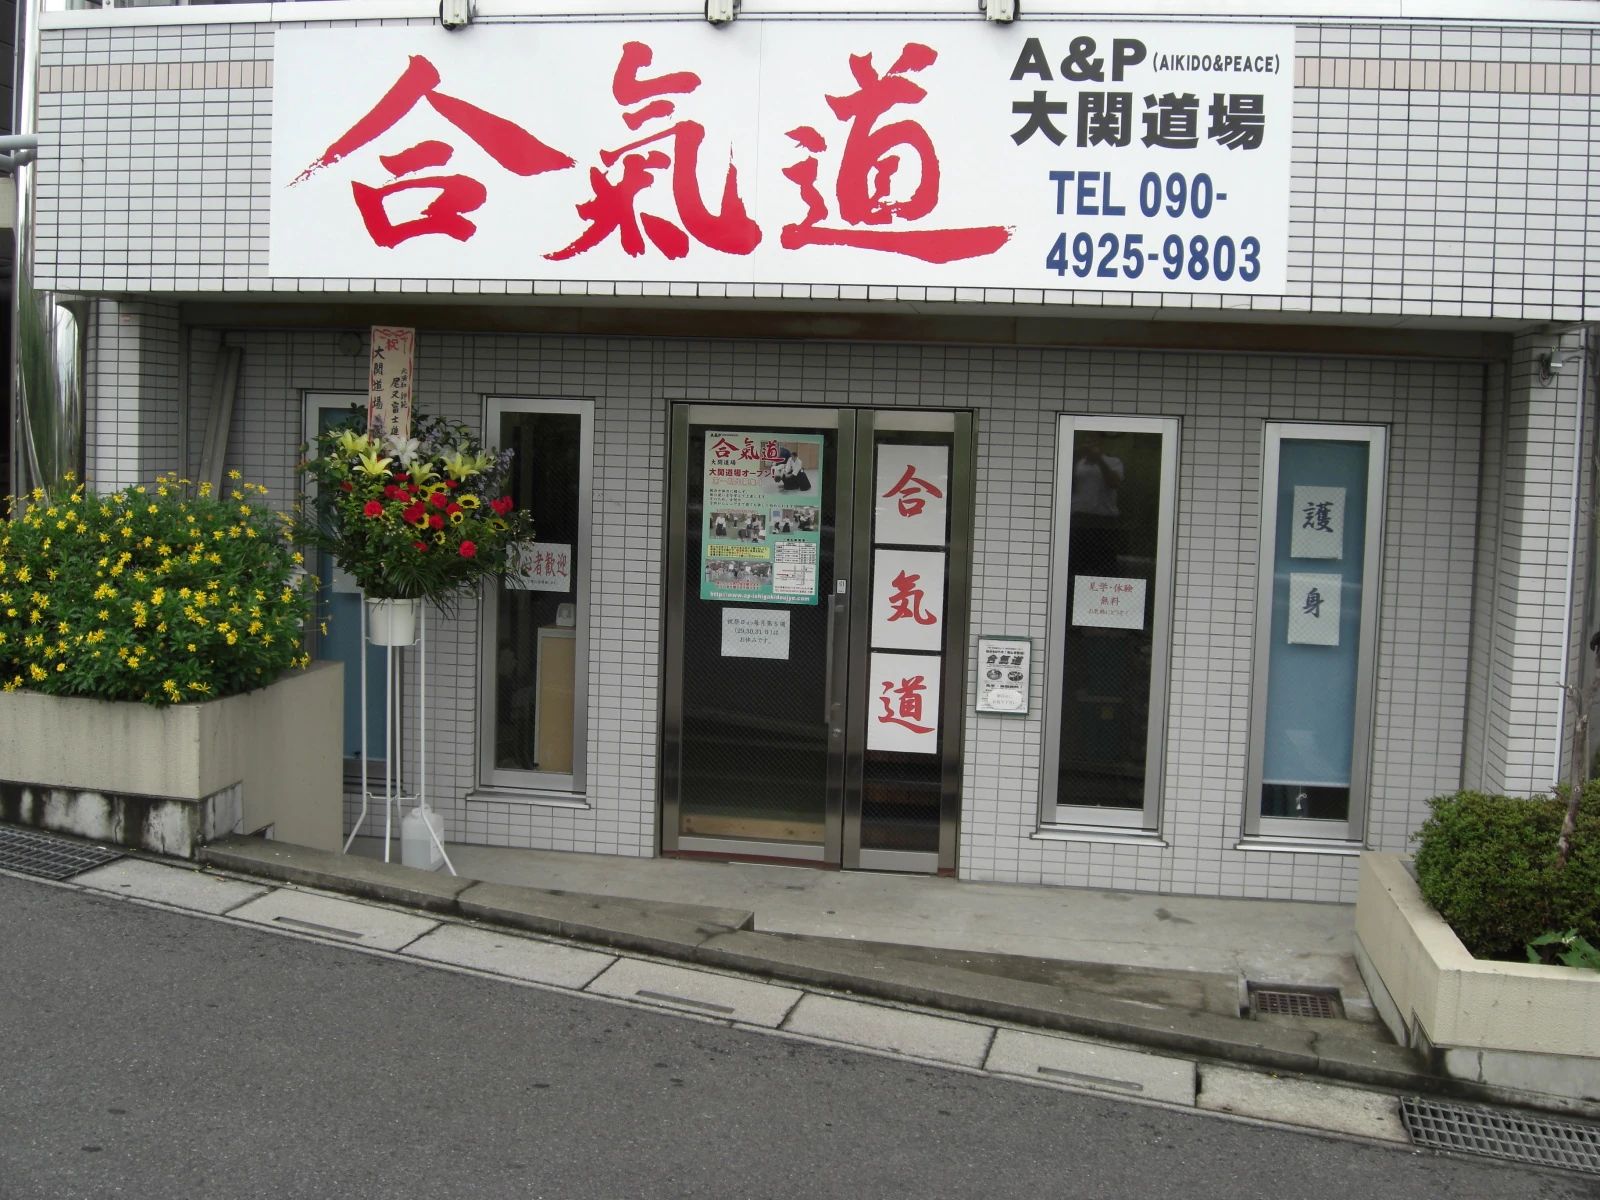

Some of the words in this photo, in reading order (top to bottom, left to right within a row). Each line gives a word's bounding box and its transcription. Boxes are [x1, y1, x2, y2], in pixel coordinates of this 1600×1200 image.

[1010, 36, 1147, 82] A&P
[1153, 52, 1280, 75] (AIKIDO&PEACE)
[1010, 90, 1265, 150] 大関道場
[288, 41, 1015, 264] 合氣道
[1049, 170, 1126, 216] TEL
[1139, 171, 1228, 219] 090-
[1046, 232, 1261, 282] 4925-9803
[1100, 595, 1121, 606] 無料
